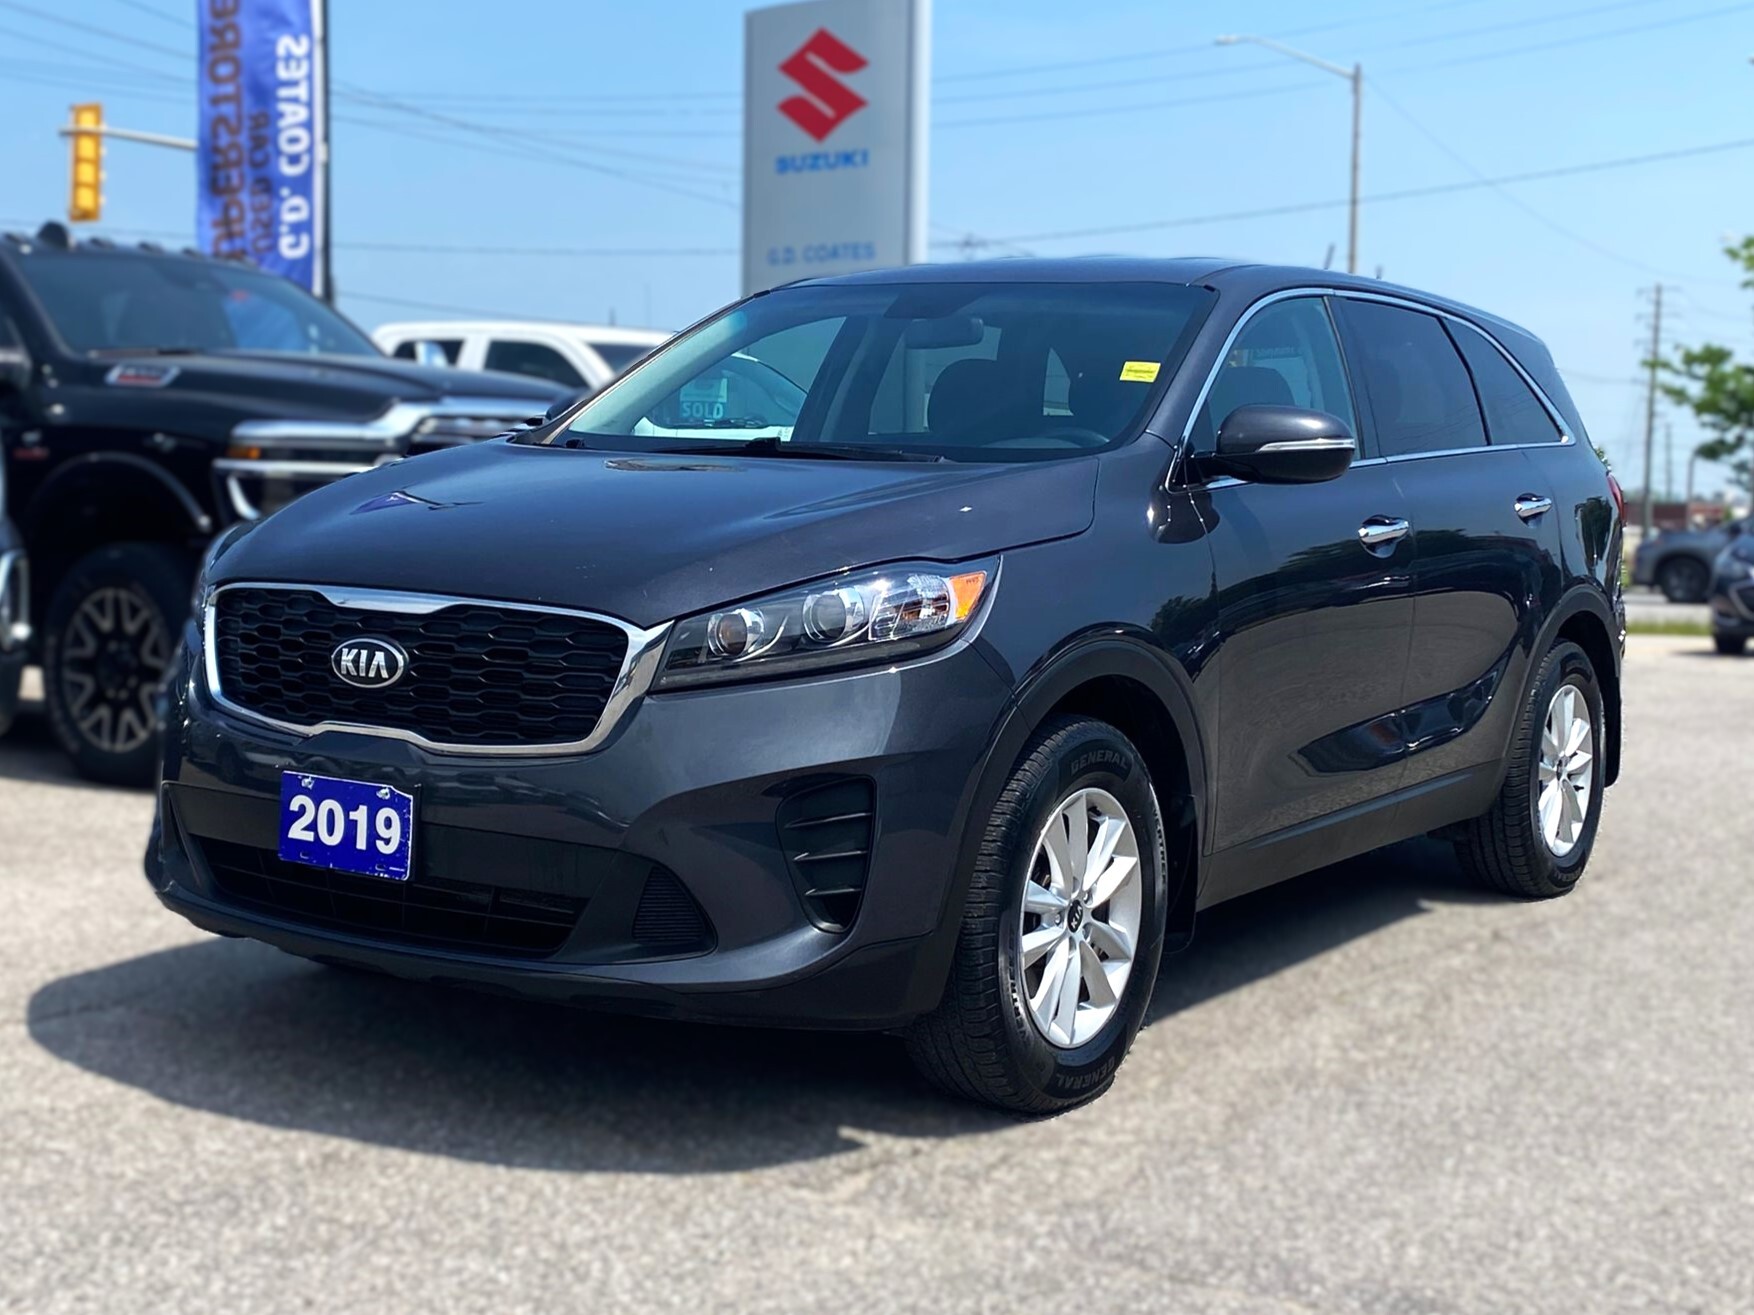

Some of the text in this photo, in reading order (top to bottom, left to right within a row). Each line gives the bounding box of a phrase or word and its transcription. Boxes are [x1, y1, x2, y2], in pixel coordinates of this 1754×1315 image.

[775, 149, 870, 175] SUZUKI
[802, 241, 877, 263] COATES
[681, 401, 724, 419] SOLD
[341, 647, 389, 679] KIA
[1070, 749, 1129, 774] GENERAL
[287, 794, 401, 855] 2019
[1070, 904, 1083, 929] KIA
[1056, 1055, 1115, 1089] GENERAL
